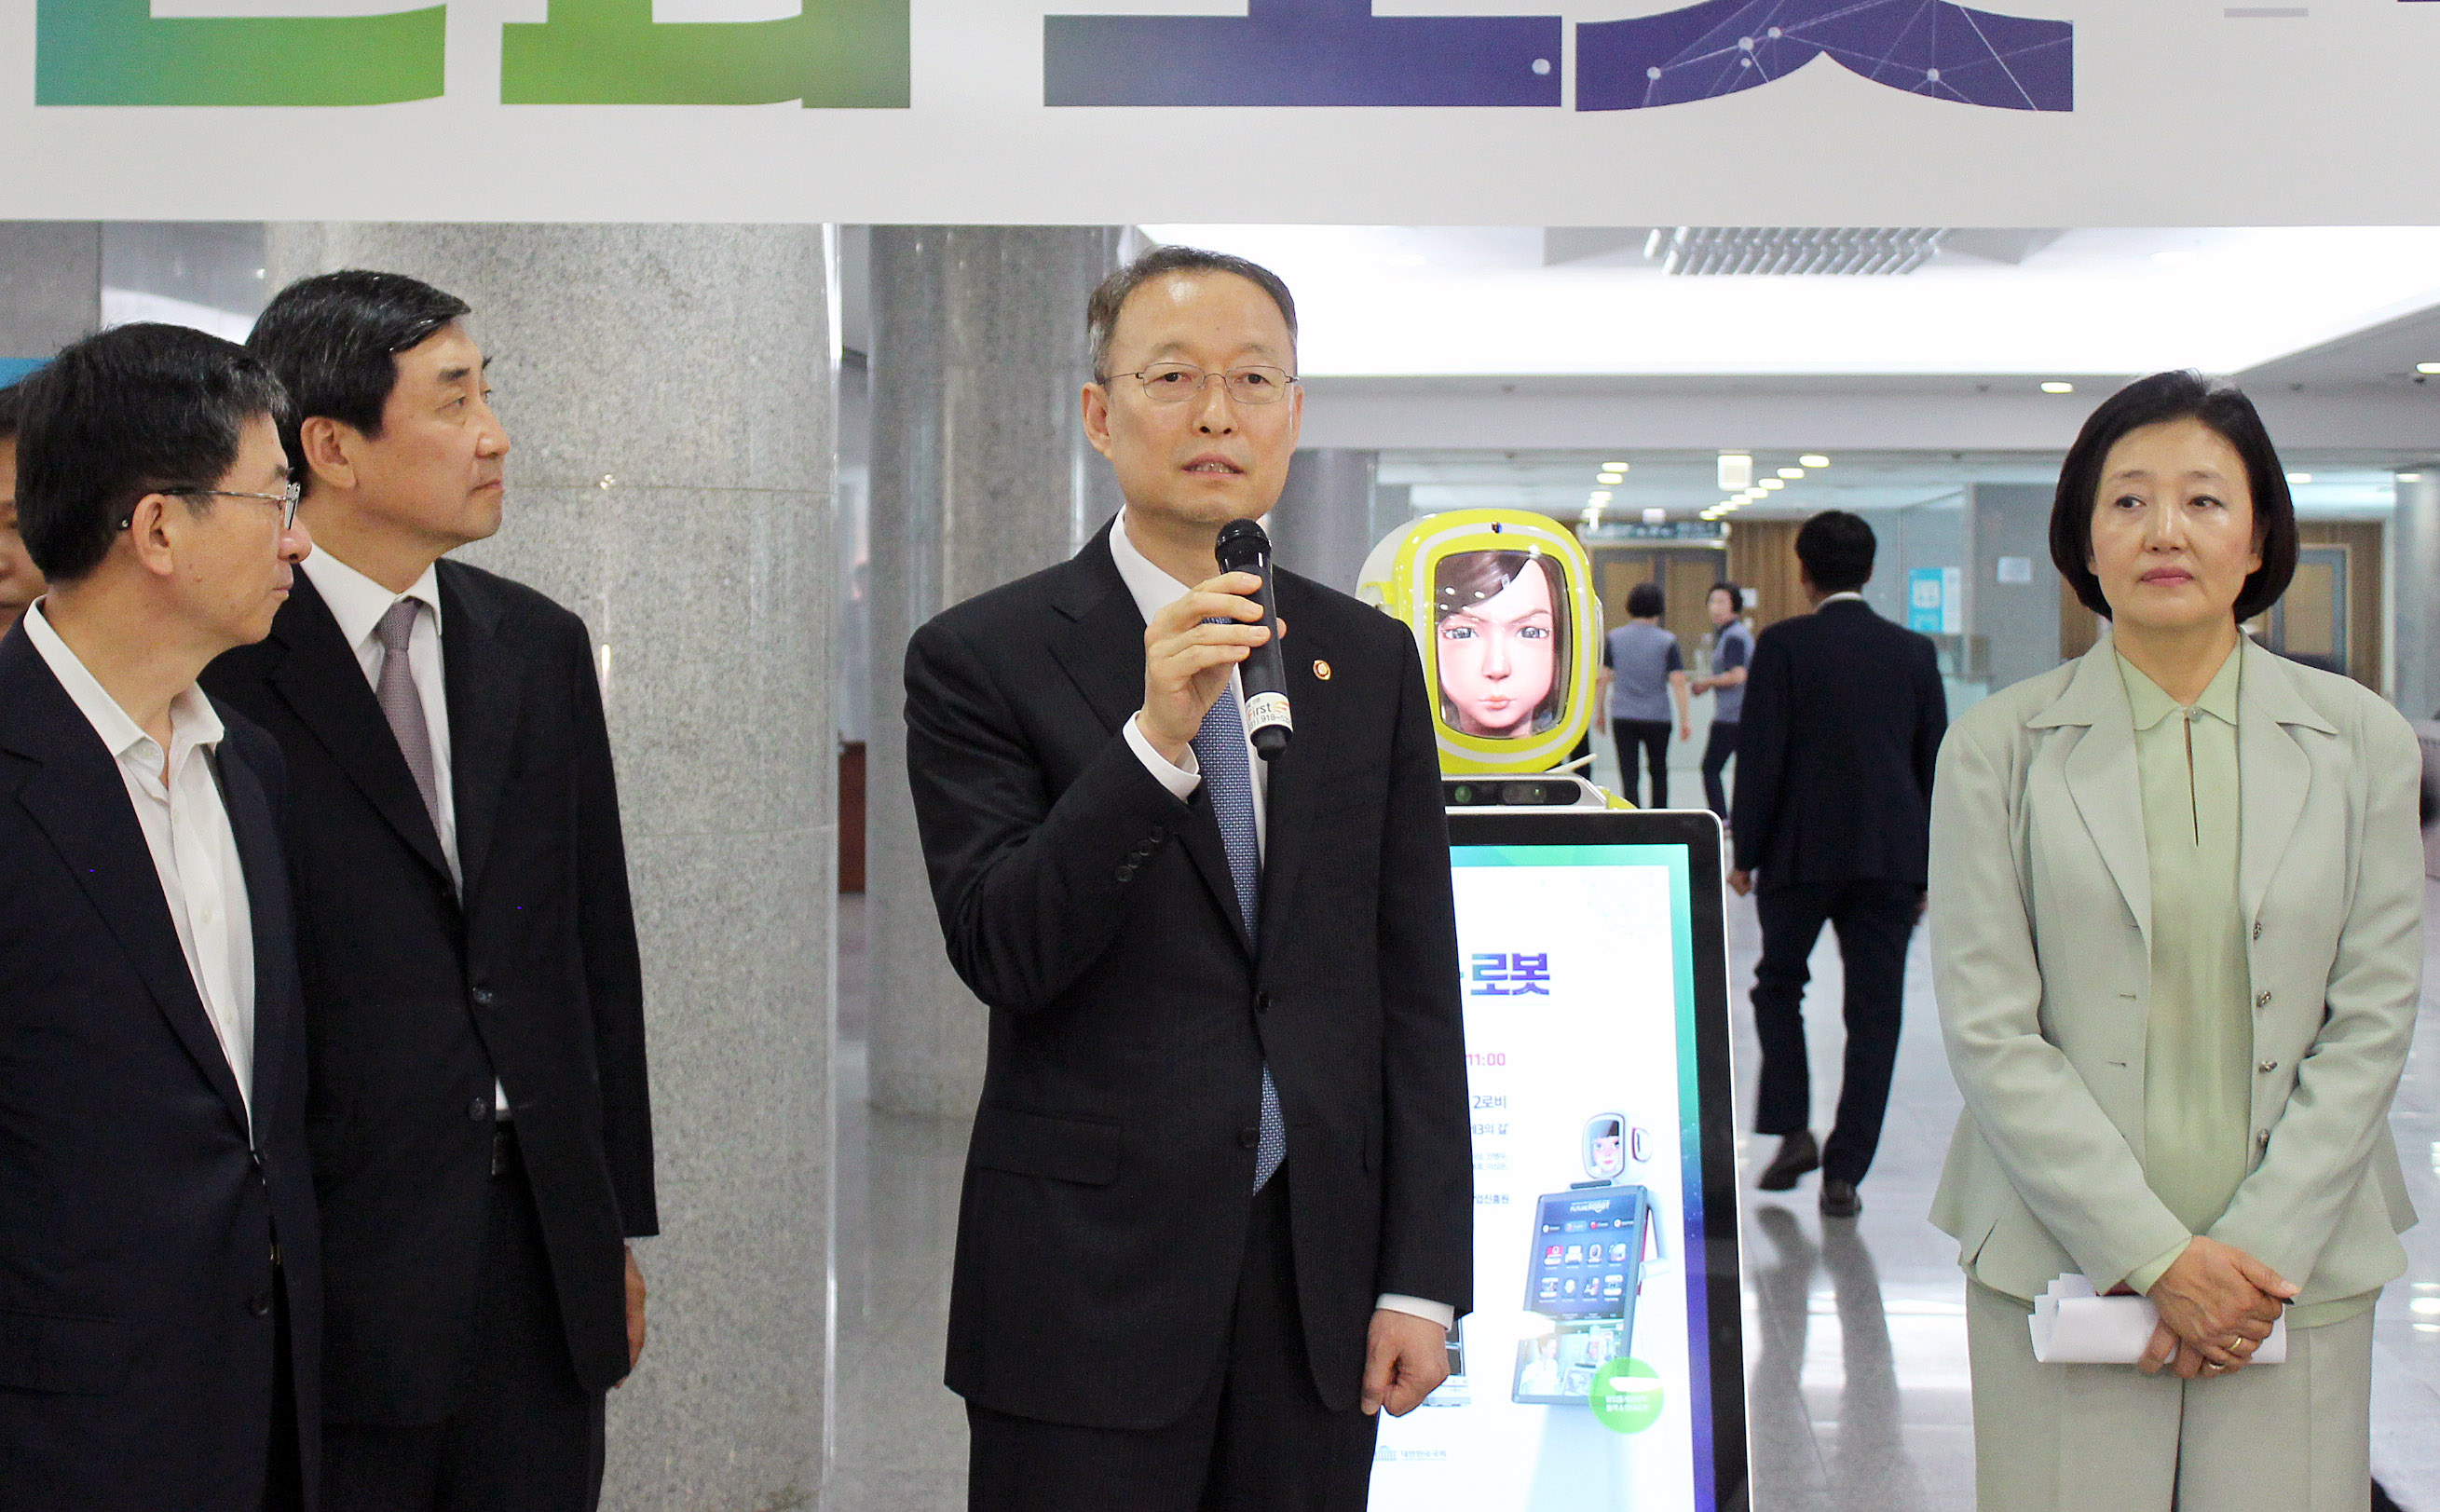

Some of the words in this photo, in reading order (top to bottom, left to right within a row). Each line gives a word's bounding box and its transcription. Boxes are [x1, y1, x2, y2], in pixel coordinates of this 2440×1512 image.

[1471, 953, 1550, 995] 로봇
[1466, 1053, 1506, 1067] 11:00
[1473, 1096, 1506, 1110] 2로비
[1474, 1193, 1509, 1205] 업진흥원
